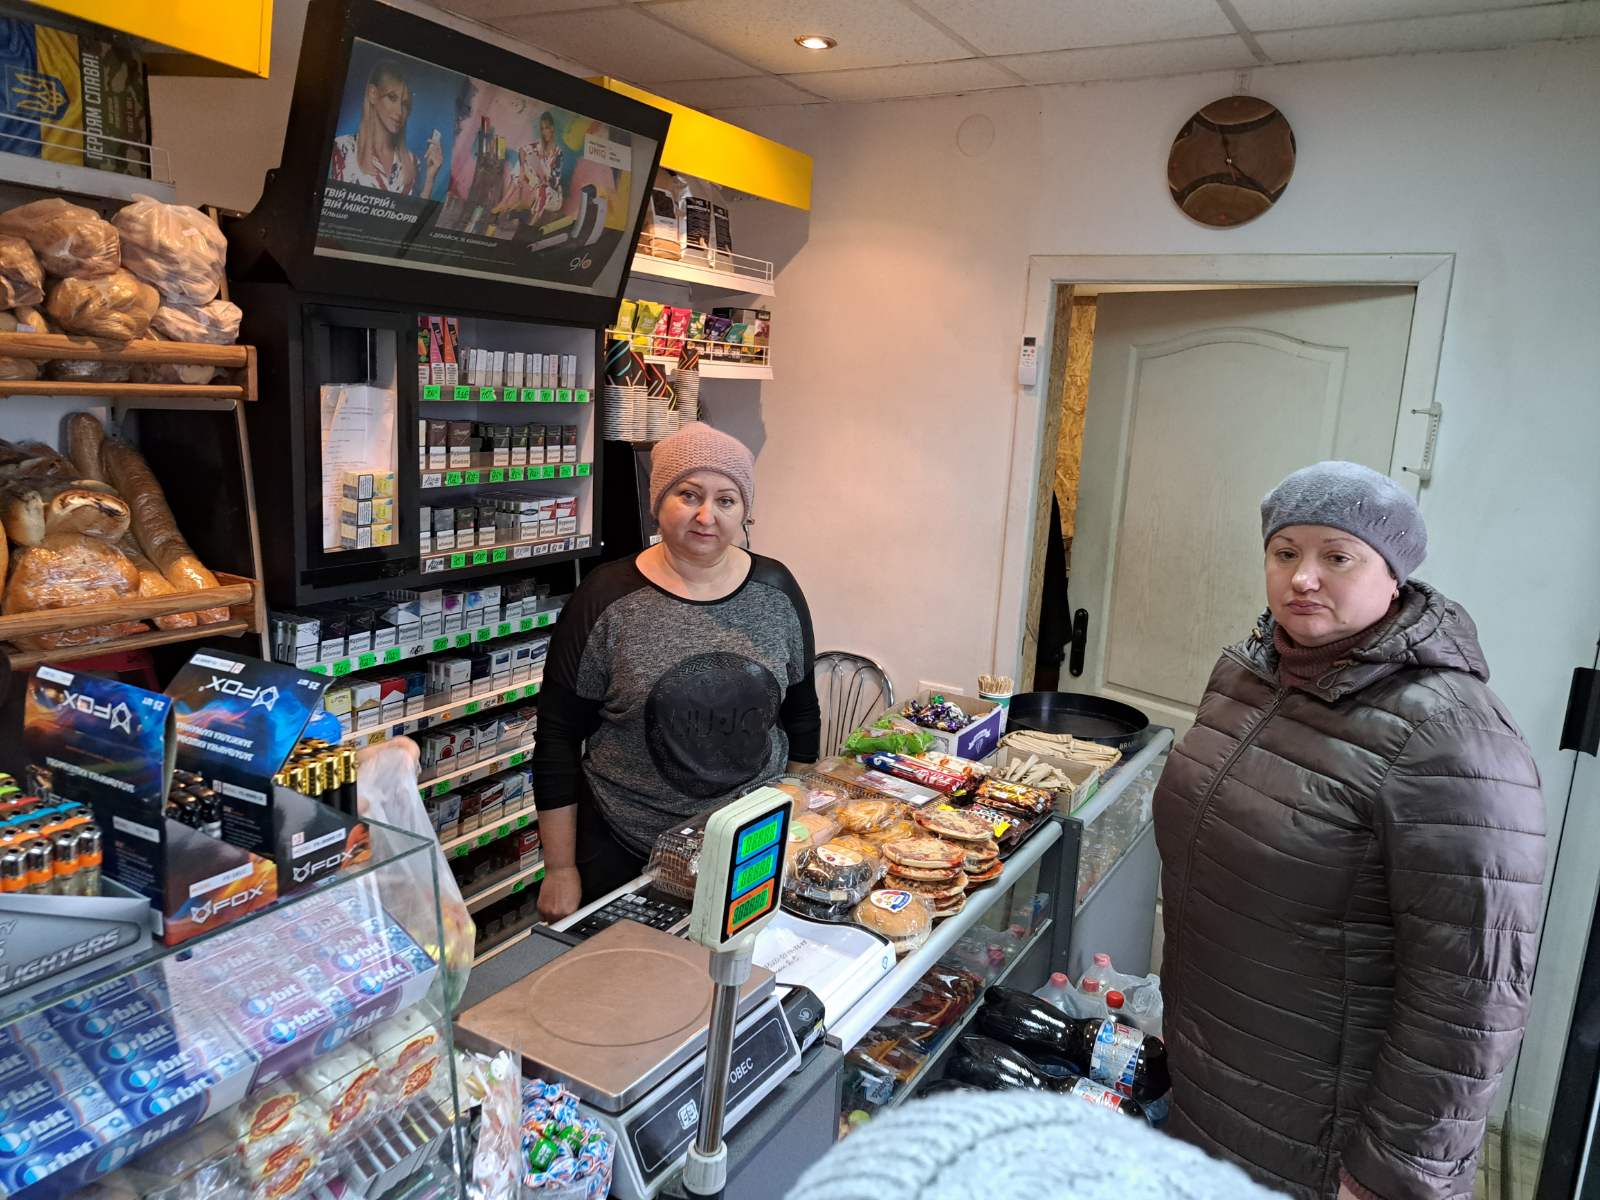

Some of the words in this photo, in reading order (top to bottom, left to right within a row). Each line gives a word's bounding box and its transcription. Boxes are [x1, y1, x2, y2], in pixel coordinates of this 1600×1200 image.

[82, 52, 102, 104] СЛАВА!
[323, 198, 342, 208] ВІЙ
[343, 203, 370, 214] МІКС
[370, 208, 418, 224] КОЛЬОРІВ
[347, 192, 390, 208] НАСТРІЙ
[61, 690, 112, 719] FOX
[204, 675, 261, 700] FOX
[311, 844, 357, 876] FOX
[213, 880, 266, 915] FOX
[337, 940, 384, 970] Orbit
[360, 963, 407, 994] Orbit
[248, 983, 301, 1017] Orbit
[85, 1001, 149, 1035] Orbit
[271, 1007, 323, 1042] Orbit
[108, 1024, 170, 1061] Orbit
[129, 1050, 193, 1090] Orbit
[728, 1057, 754, 1085] ОВЕС
[150, 1077, 212, 1115] Orbit
[96, 1115, 187, 1172] Orbit
[23, 1139, 96, 1184] Orbit
